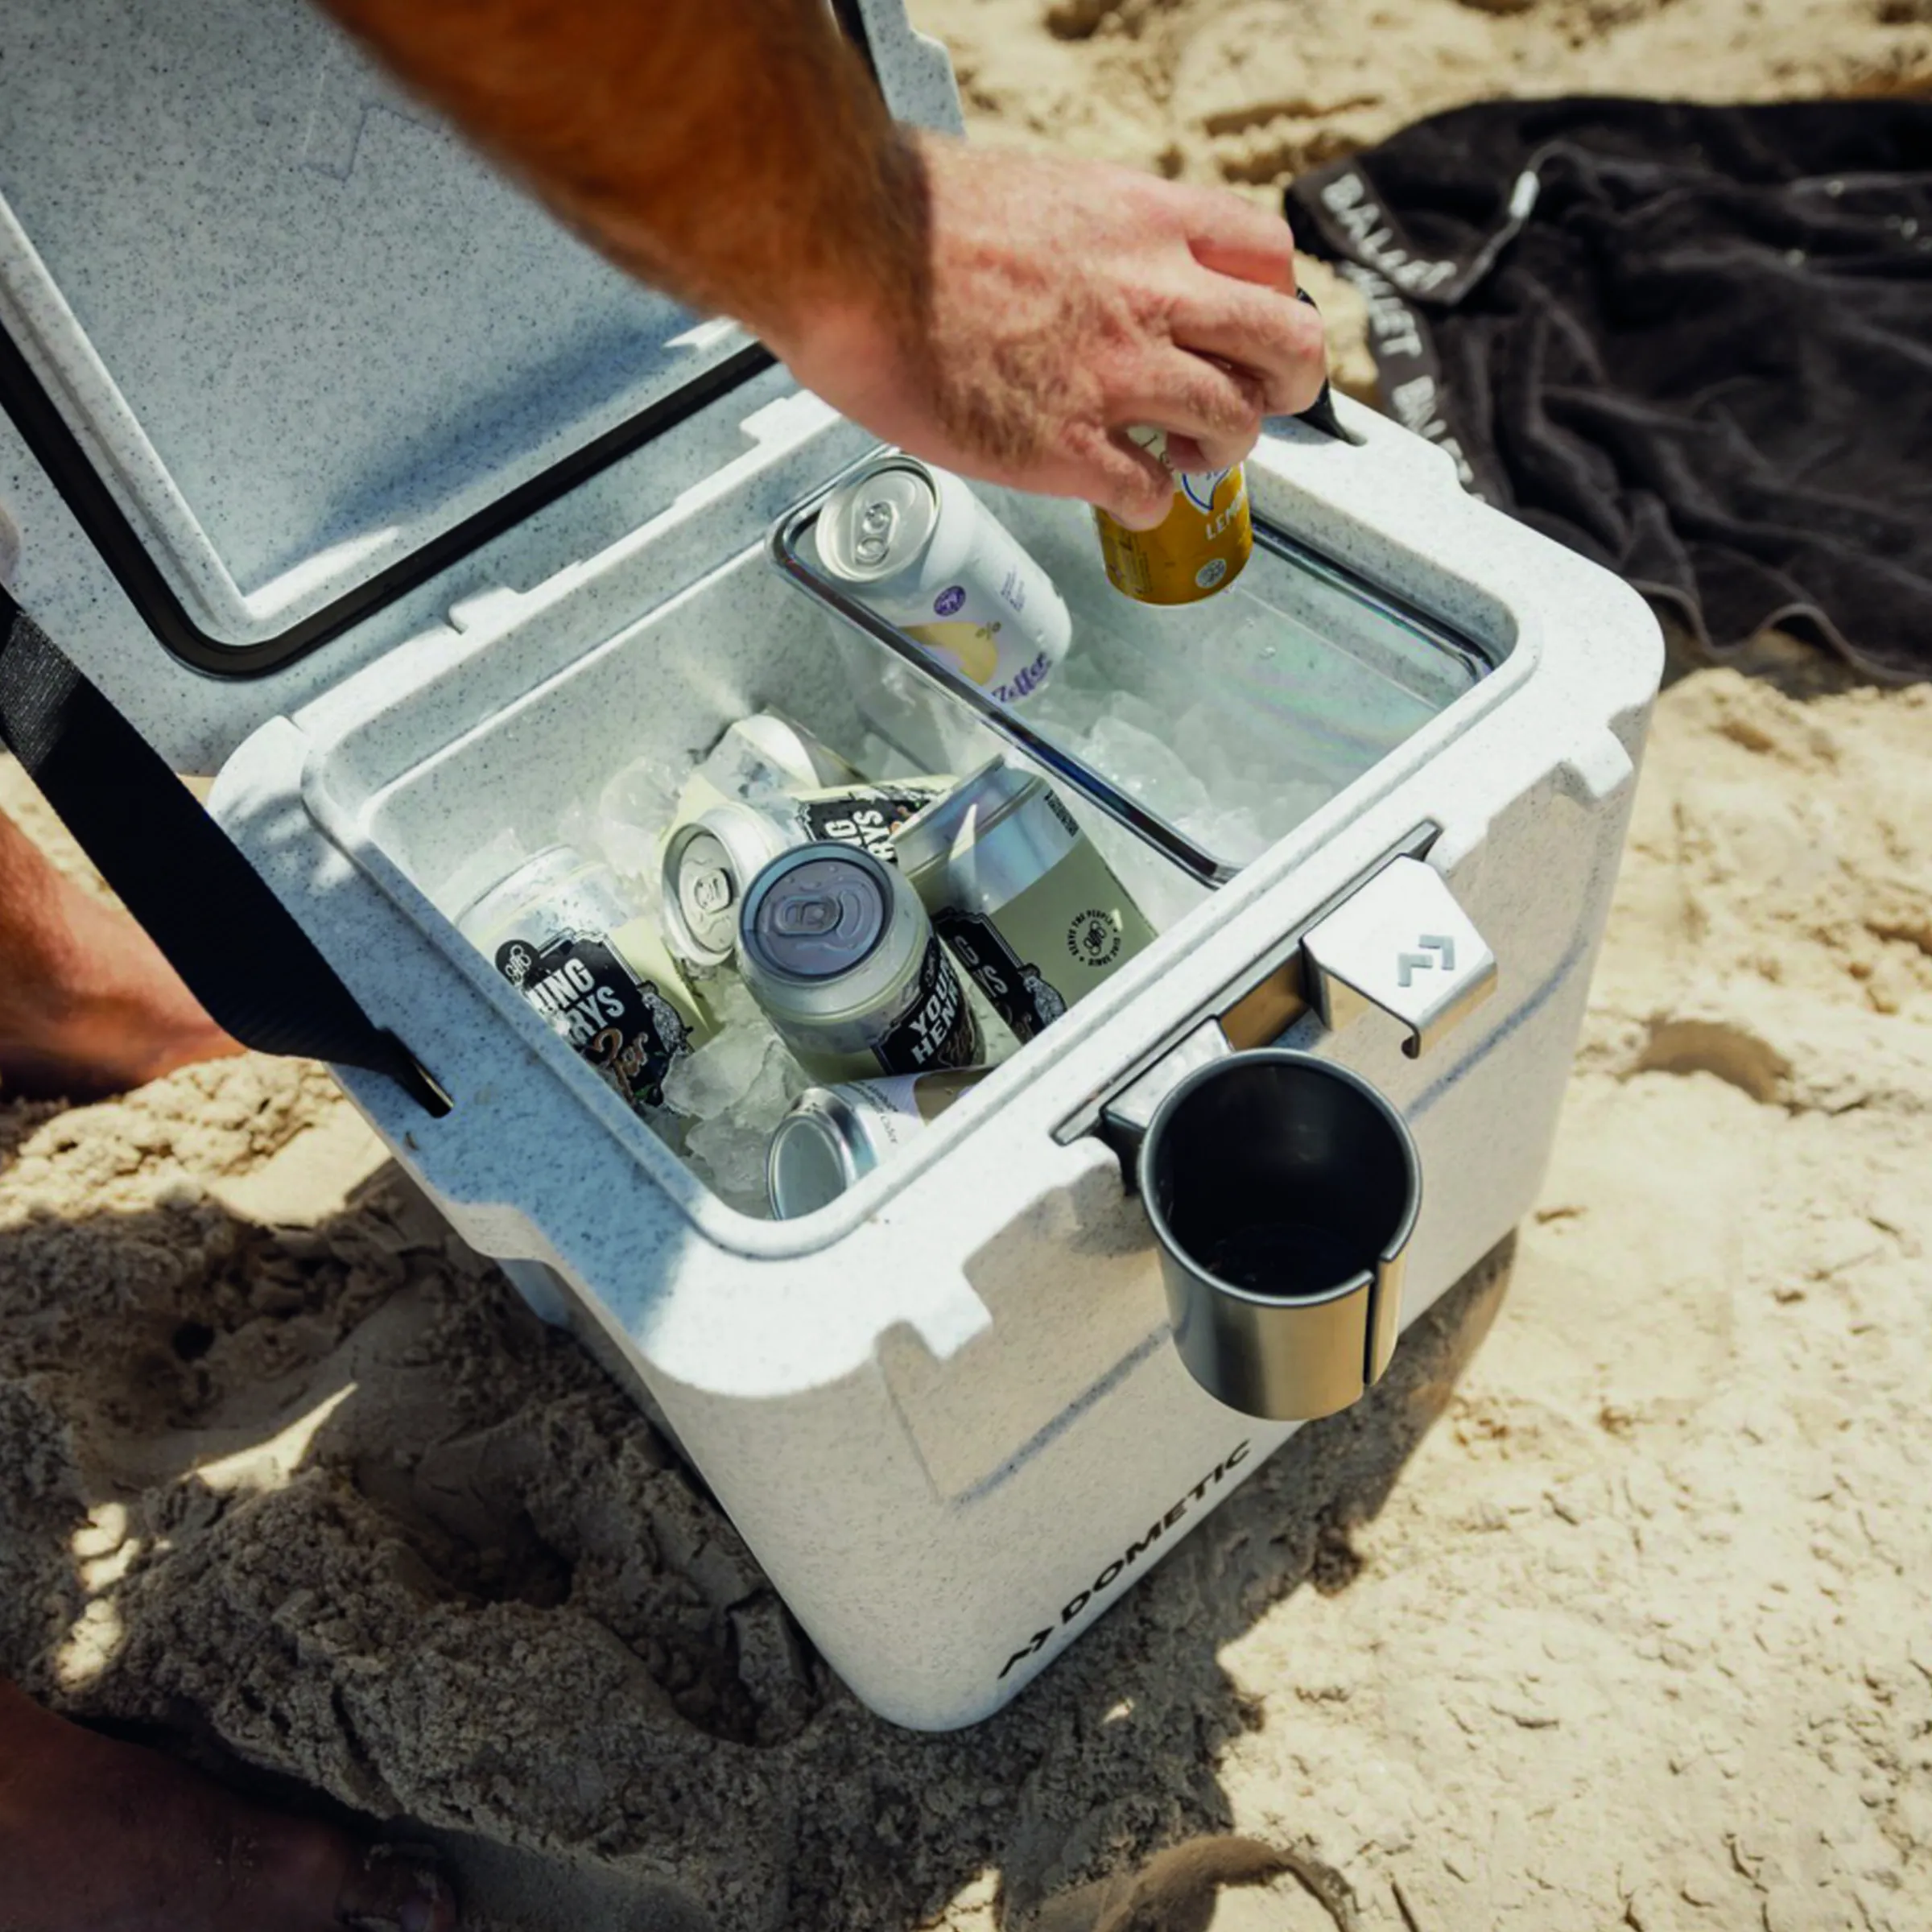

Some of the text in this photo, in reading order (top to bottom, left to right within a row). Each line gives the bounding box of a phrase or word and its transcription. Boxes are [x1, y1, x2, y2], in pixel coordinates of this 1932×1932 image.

[852, 809, 895, 861] RYS
[563, 985, 626, 1046] RYS
[1060, 1439, 1250, 1624] DOMETIC
